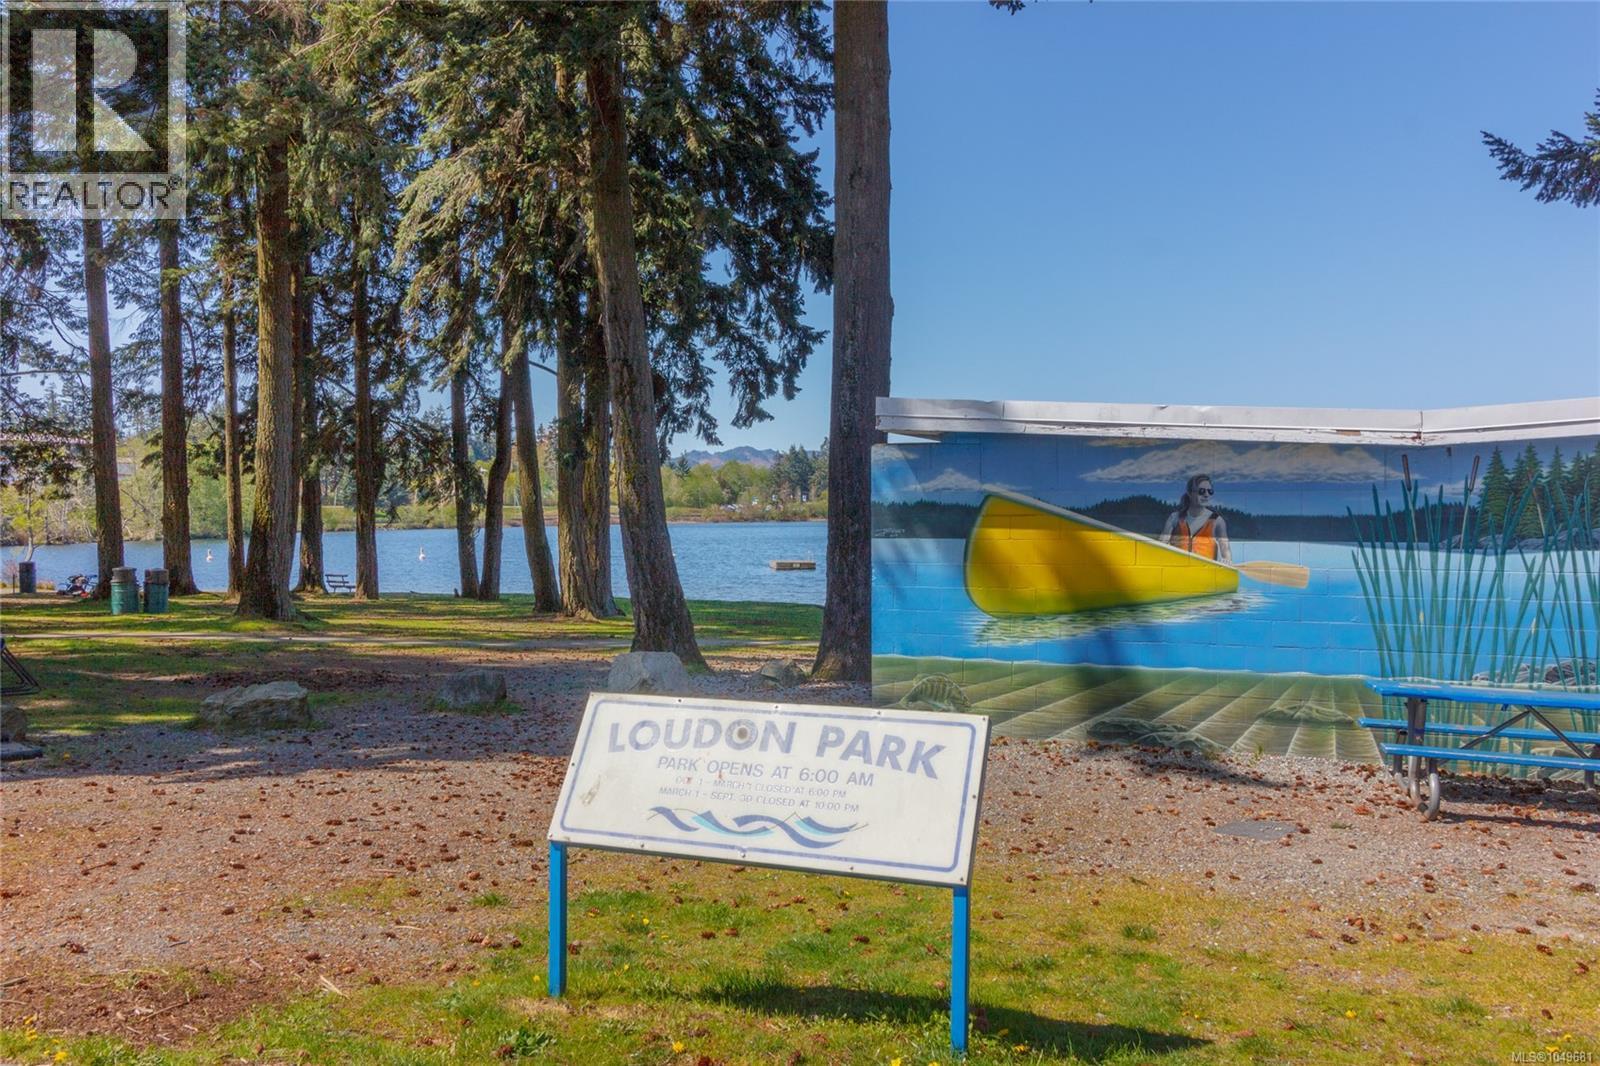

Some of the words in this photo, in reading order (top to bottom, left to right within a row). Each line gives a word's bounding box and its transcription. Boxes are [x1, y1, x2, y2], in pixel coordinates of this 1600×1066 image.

[608, 718, 796, 753] LOUDON
[816, 725, 946, 779] PARK
[657, 756, 699, 772] PARK
[707, 760, 764, 777] OPENS
[771, 766, 793, 780] AT
[799, 768, 839, 783] 6:00
[846, 772, 875, 786] AM
[658, 786, 692, 797] MARCH
[756, 795, 796, 807] CLOSED
[799, 799, 810, 808] AT
[844, 803, 860, 813] PM
[713, 779, 745, 790] MARCH
[755, 783, 791, 794] CLOSED
[794, 786, 805, 794] AT
[808, 787, 830, 797] 6:00
[832, 789, 847, 799] PM
